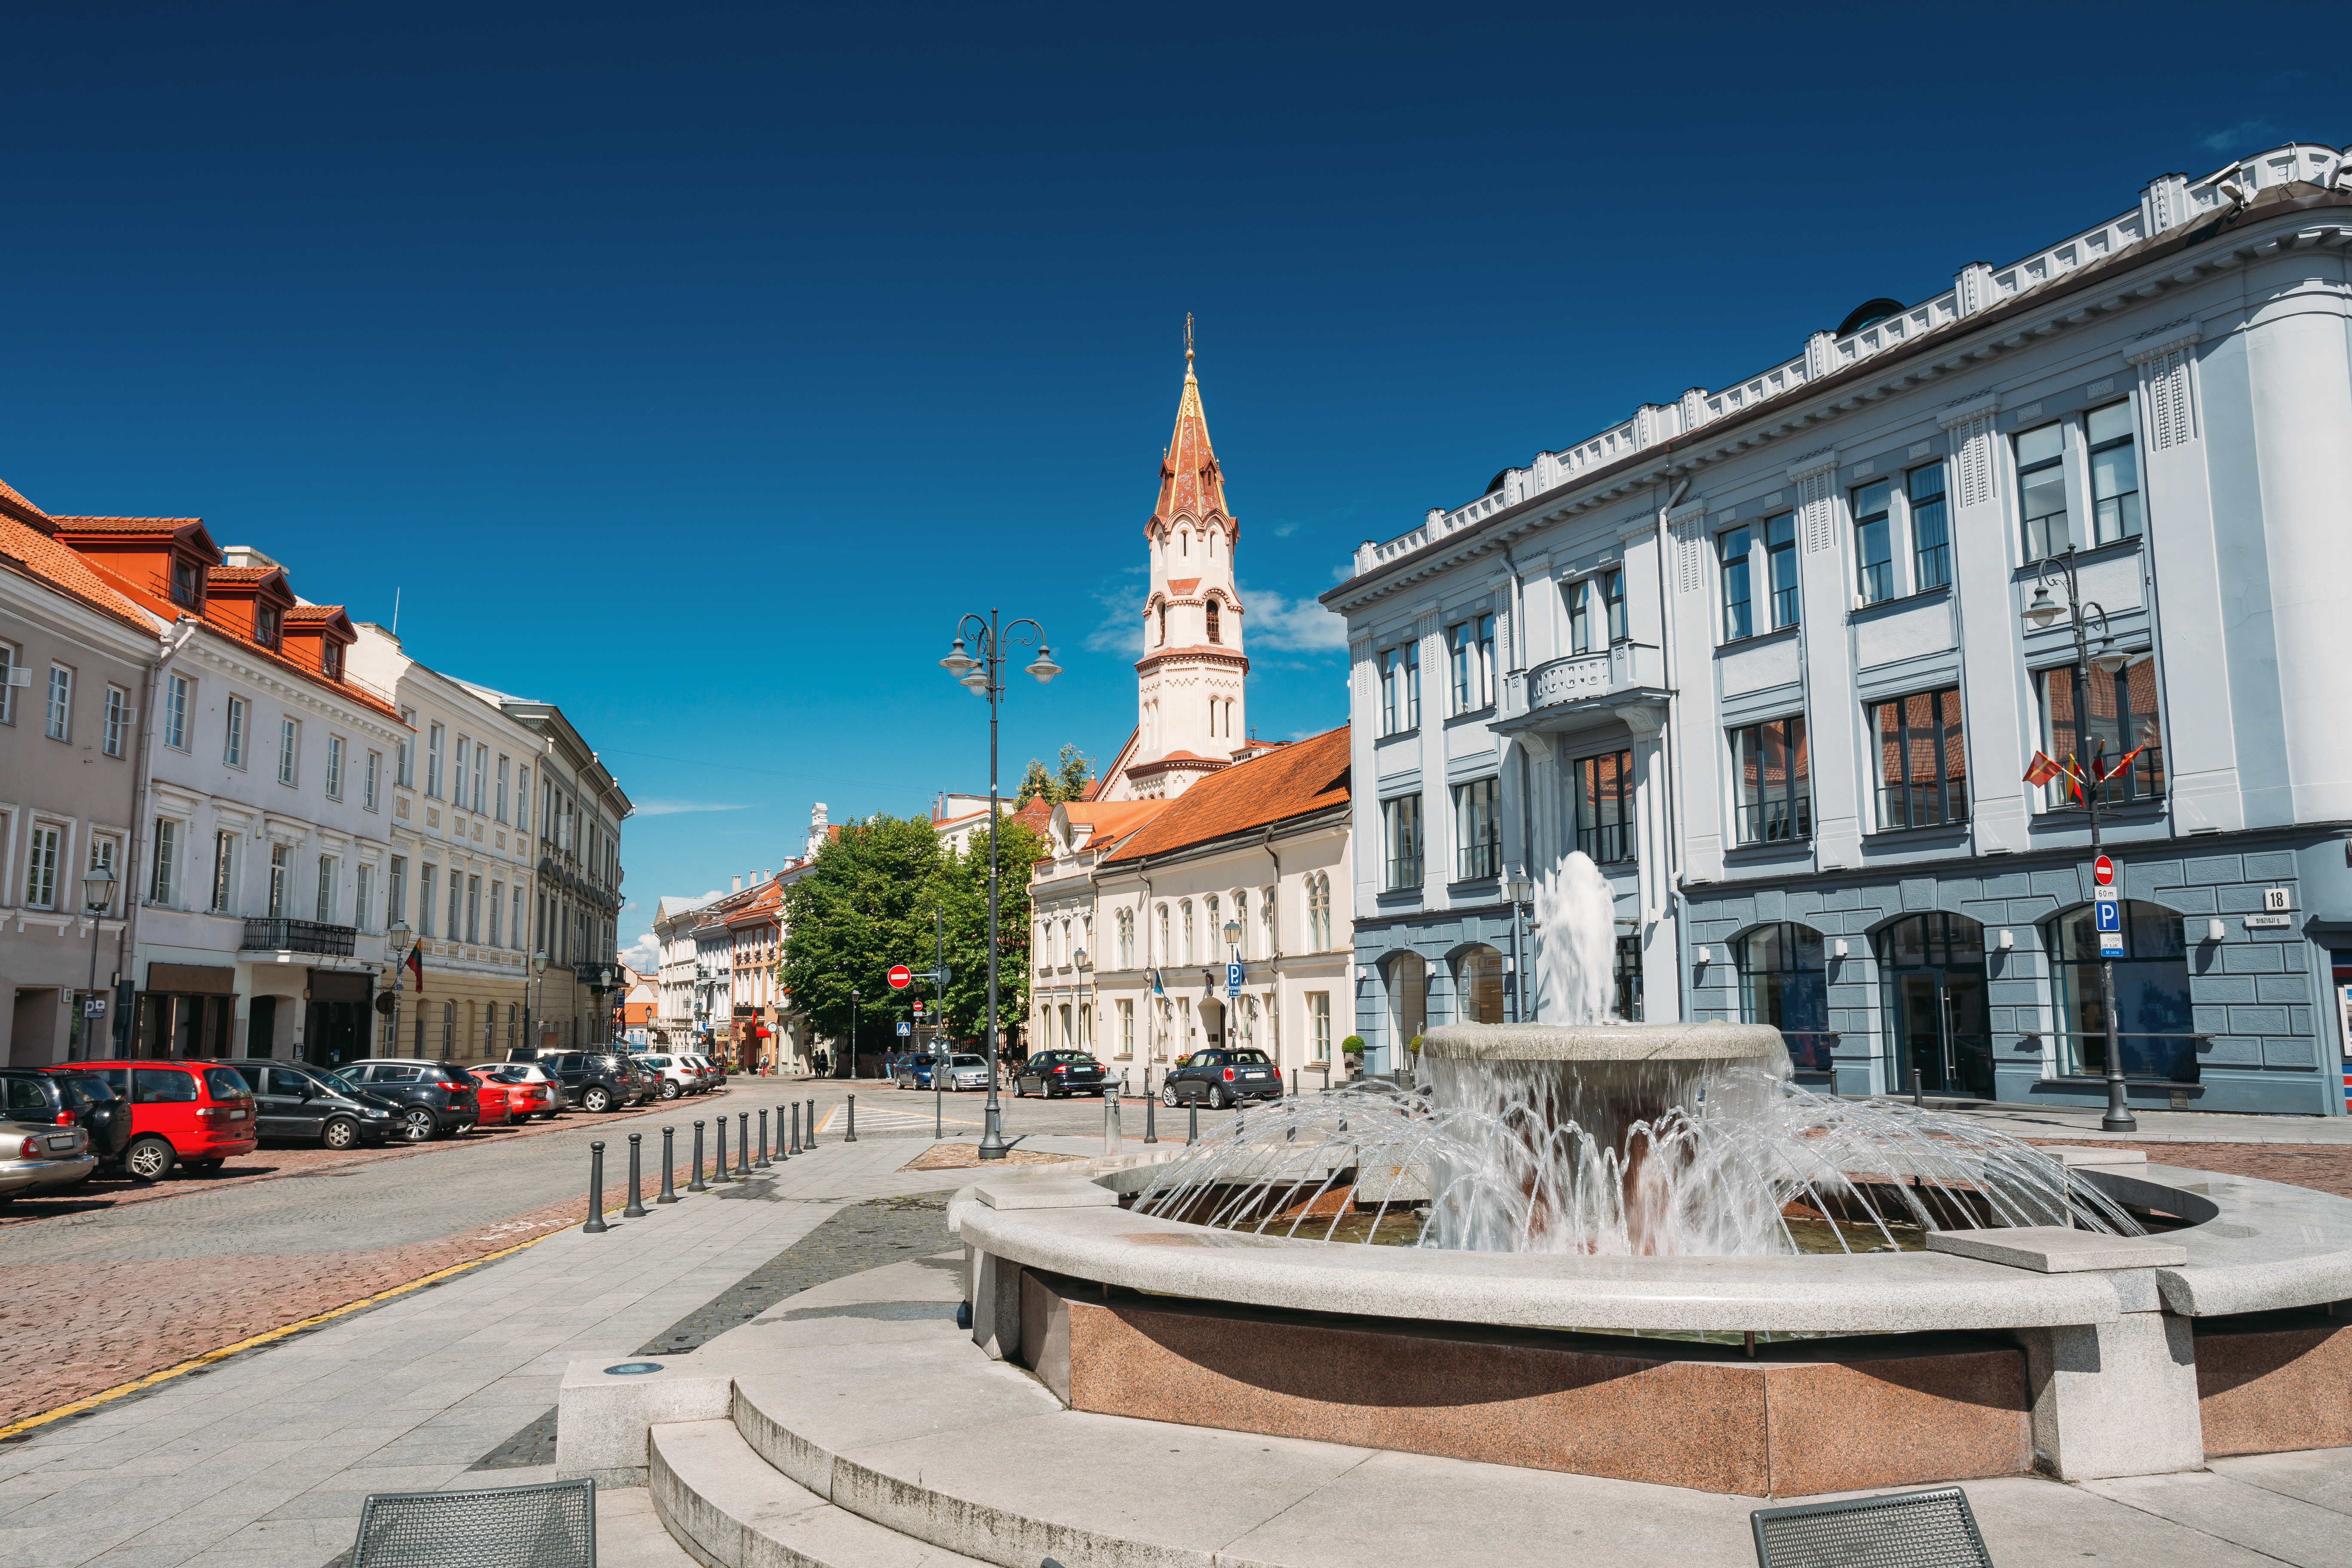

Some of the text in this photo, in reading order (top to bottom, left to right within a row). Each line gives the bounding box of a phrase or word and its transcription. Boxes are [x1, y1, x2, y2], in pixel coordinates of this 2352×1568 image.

[2270, 892, 2283, 907] 18
[2101, 904, 2114, 928] P
[1231, 965, 1239, 984] P
[66, 990, 71, 1001] 13
[84, 1001, 94, 1017] P
